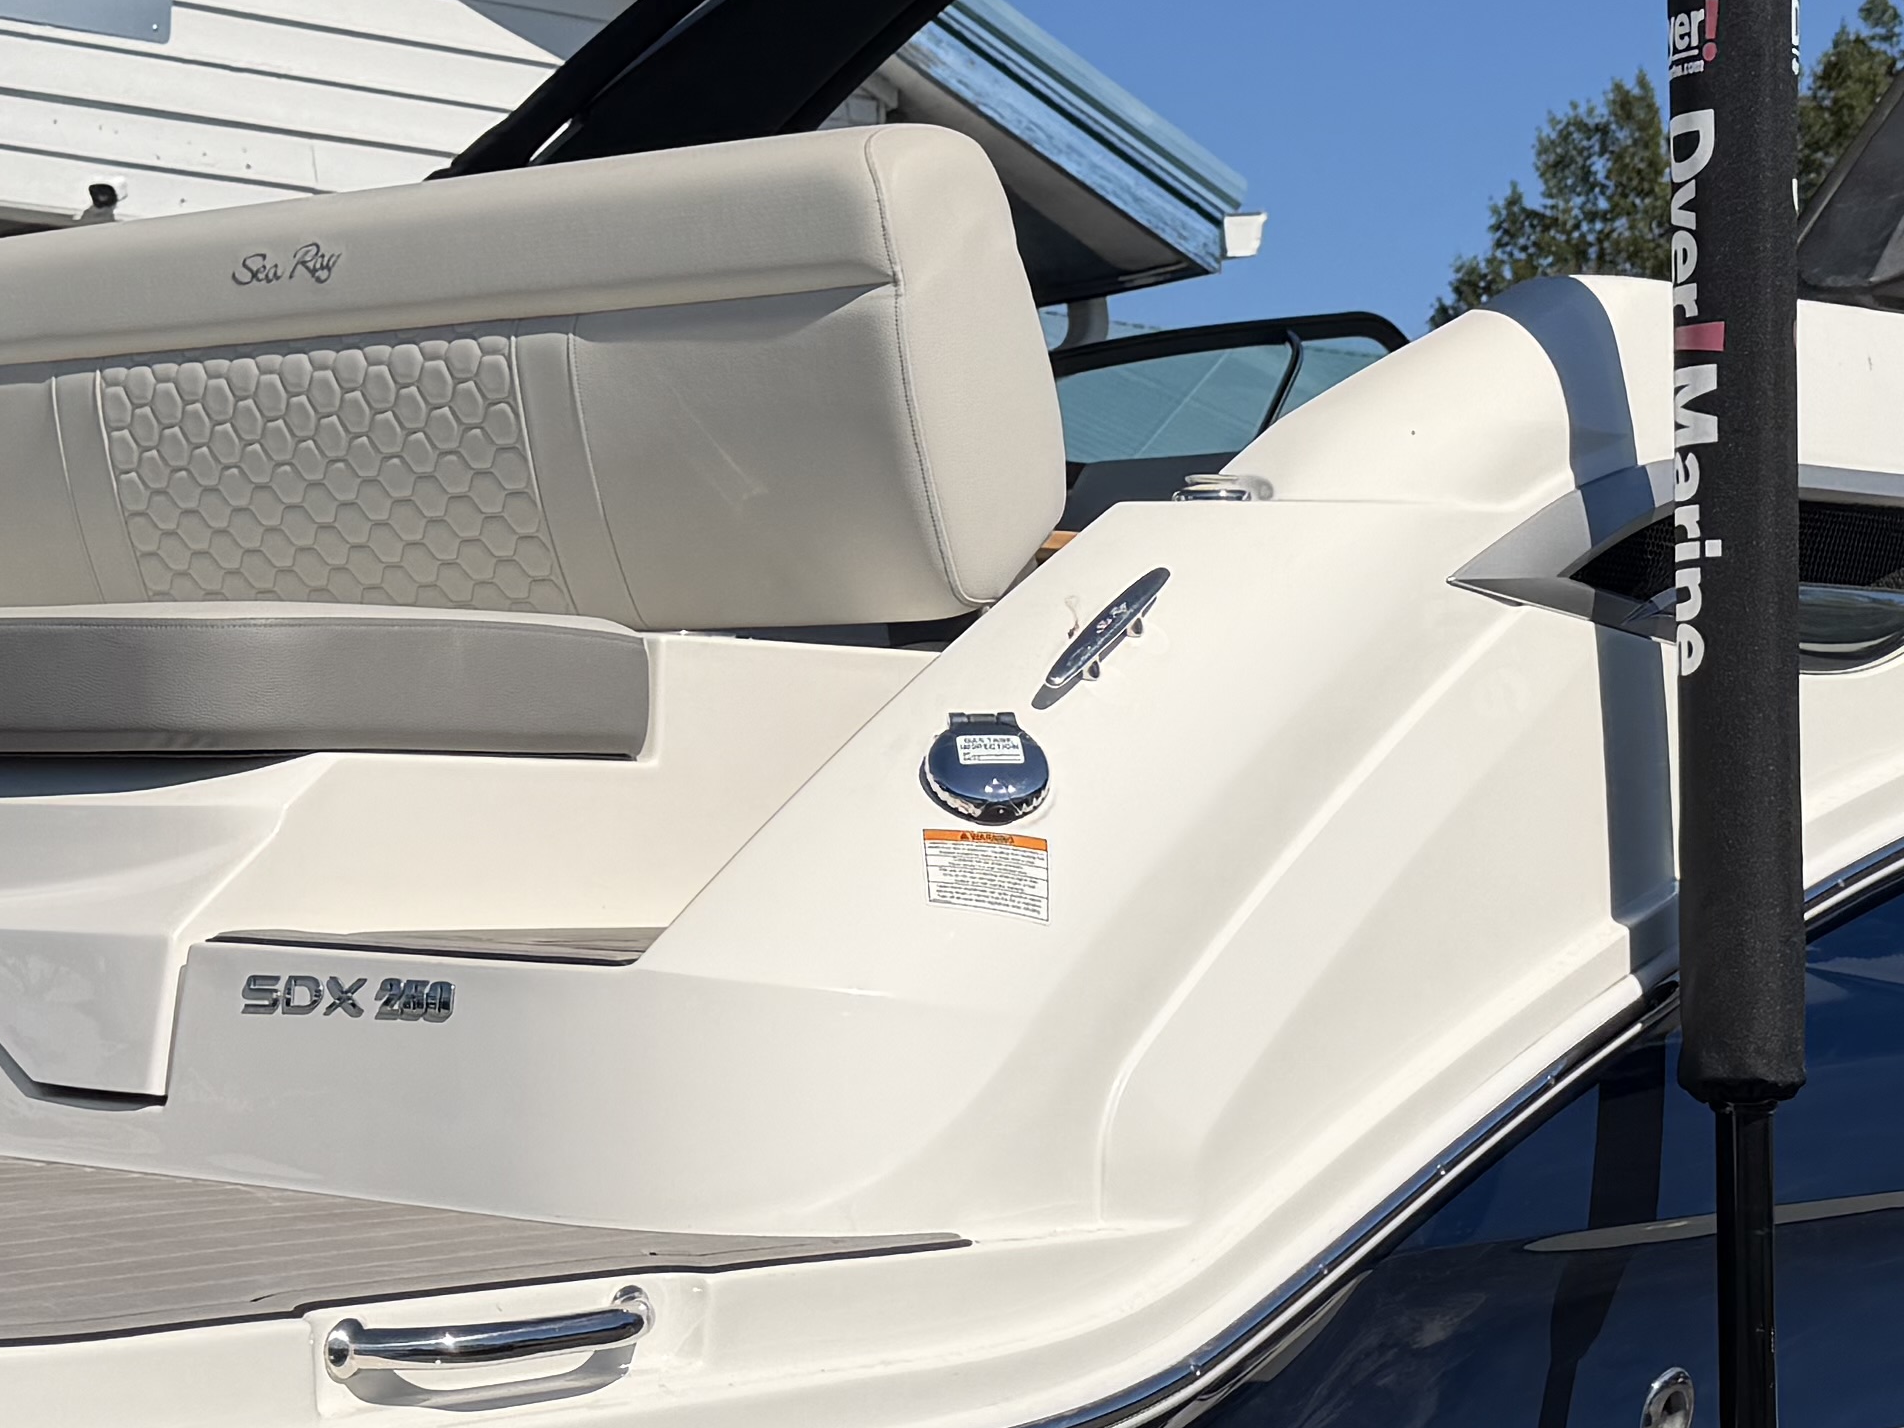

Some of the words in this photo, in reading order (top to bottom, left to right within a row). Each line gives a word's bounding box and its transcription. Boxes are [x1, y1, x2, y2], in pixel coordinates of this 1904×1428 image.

[232, 253, 283, 285] Sea
[289, 241, 343, 285] Ray
[241, 974, 368, 1018] SDX
